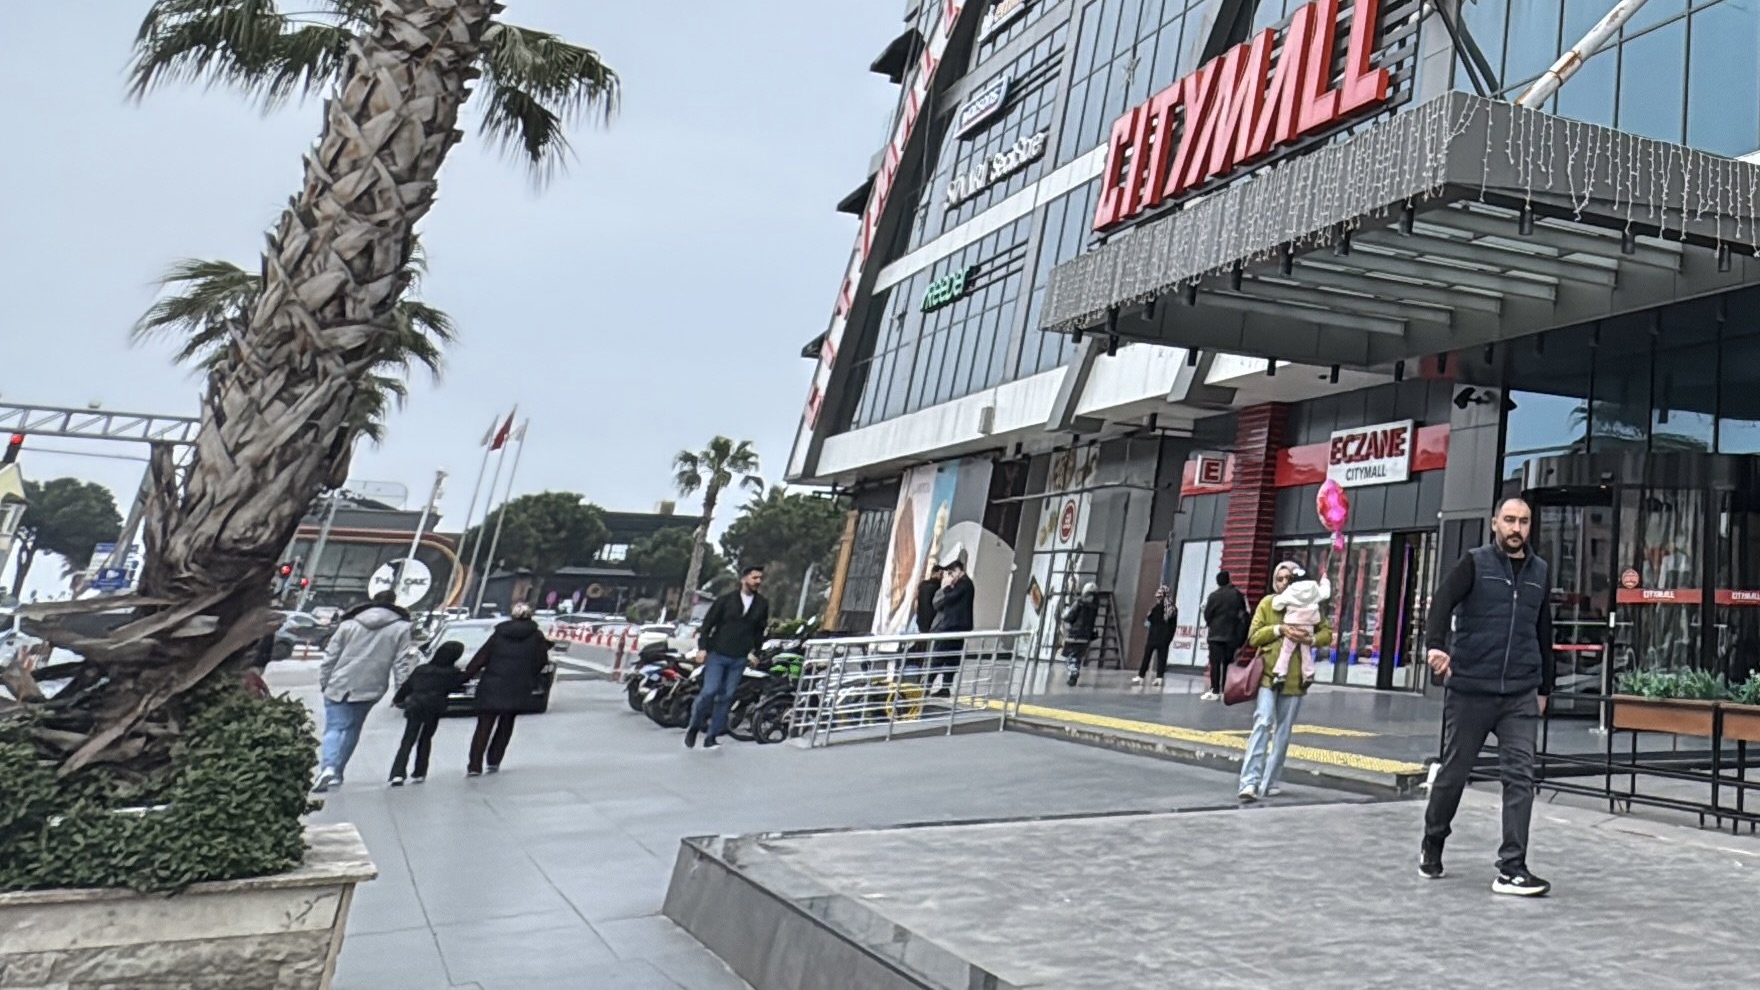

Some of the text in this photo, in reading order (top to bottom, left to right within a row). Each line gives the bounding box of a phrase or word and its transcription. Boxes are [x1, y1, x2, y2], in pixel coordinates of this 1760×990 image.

[1328, 426, 1408, 466] ECZANE
[1203, 461, 1221, 481] E
[1345, 465, 1387, 482] CITYMALL
